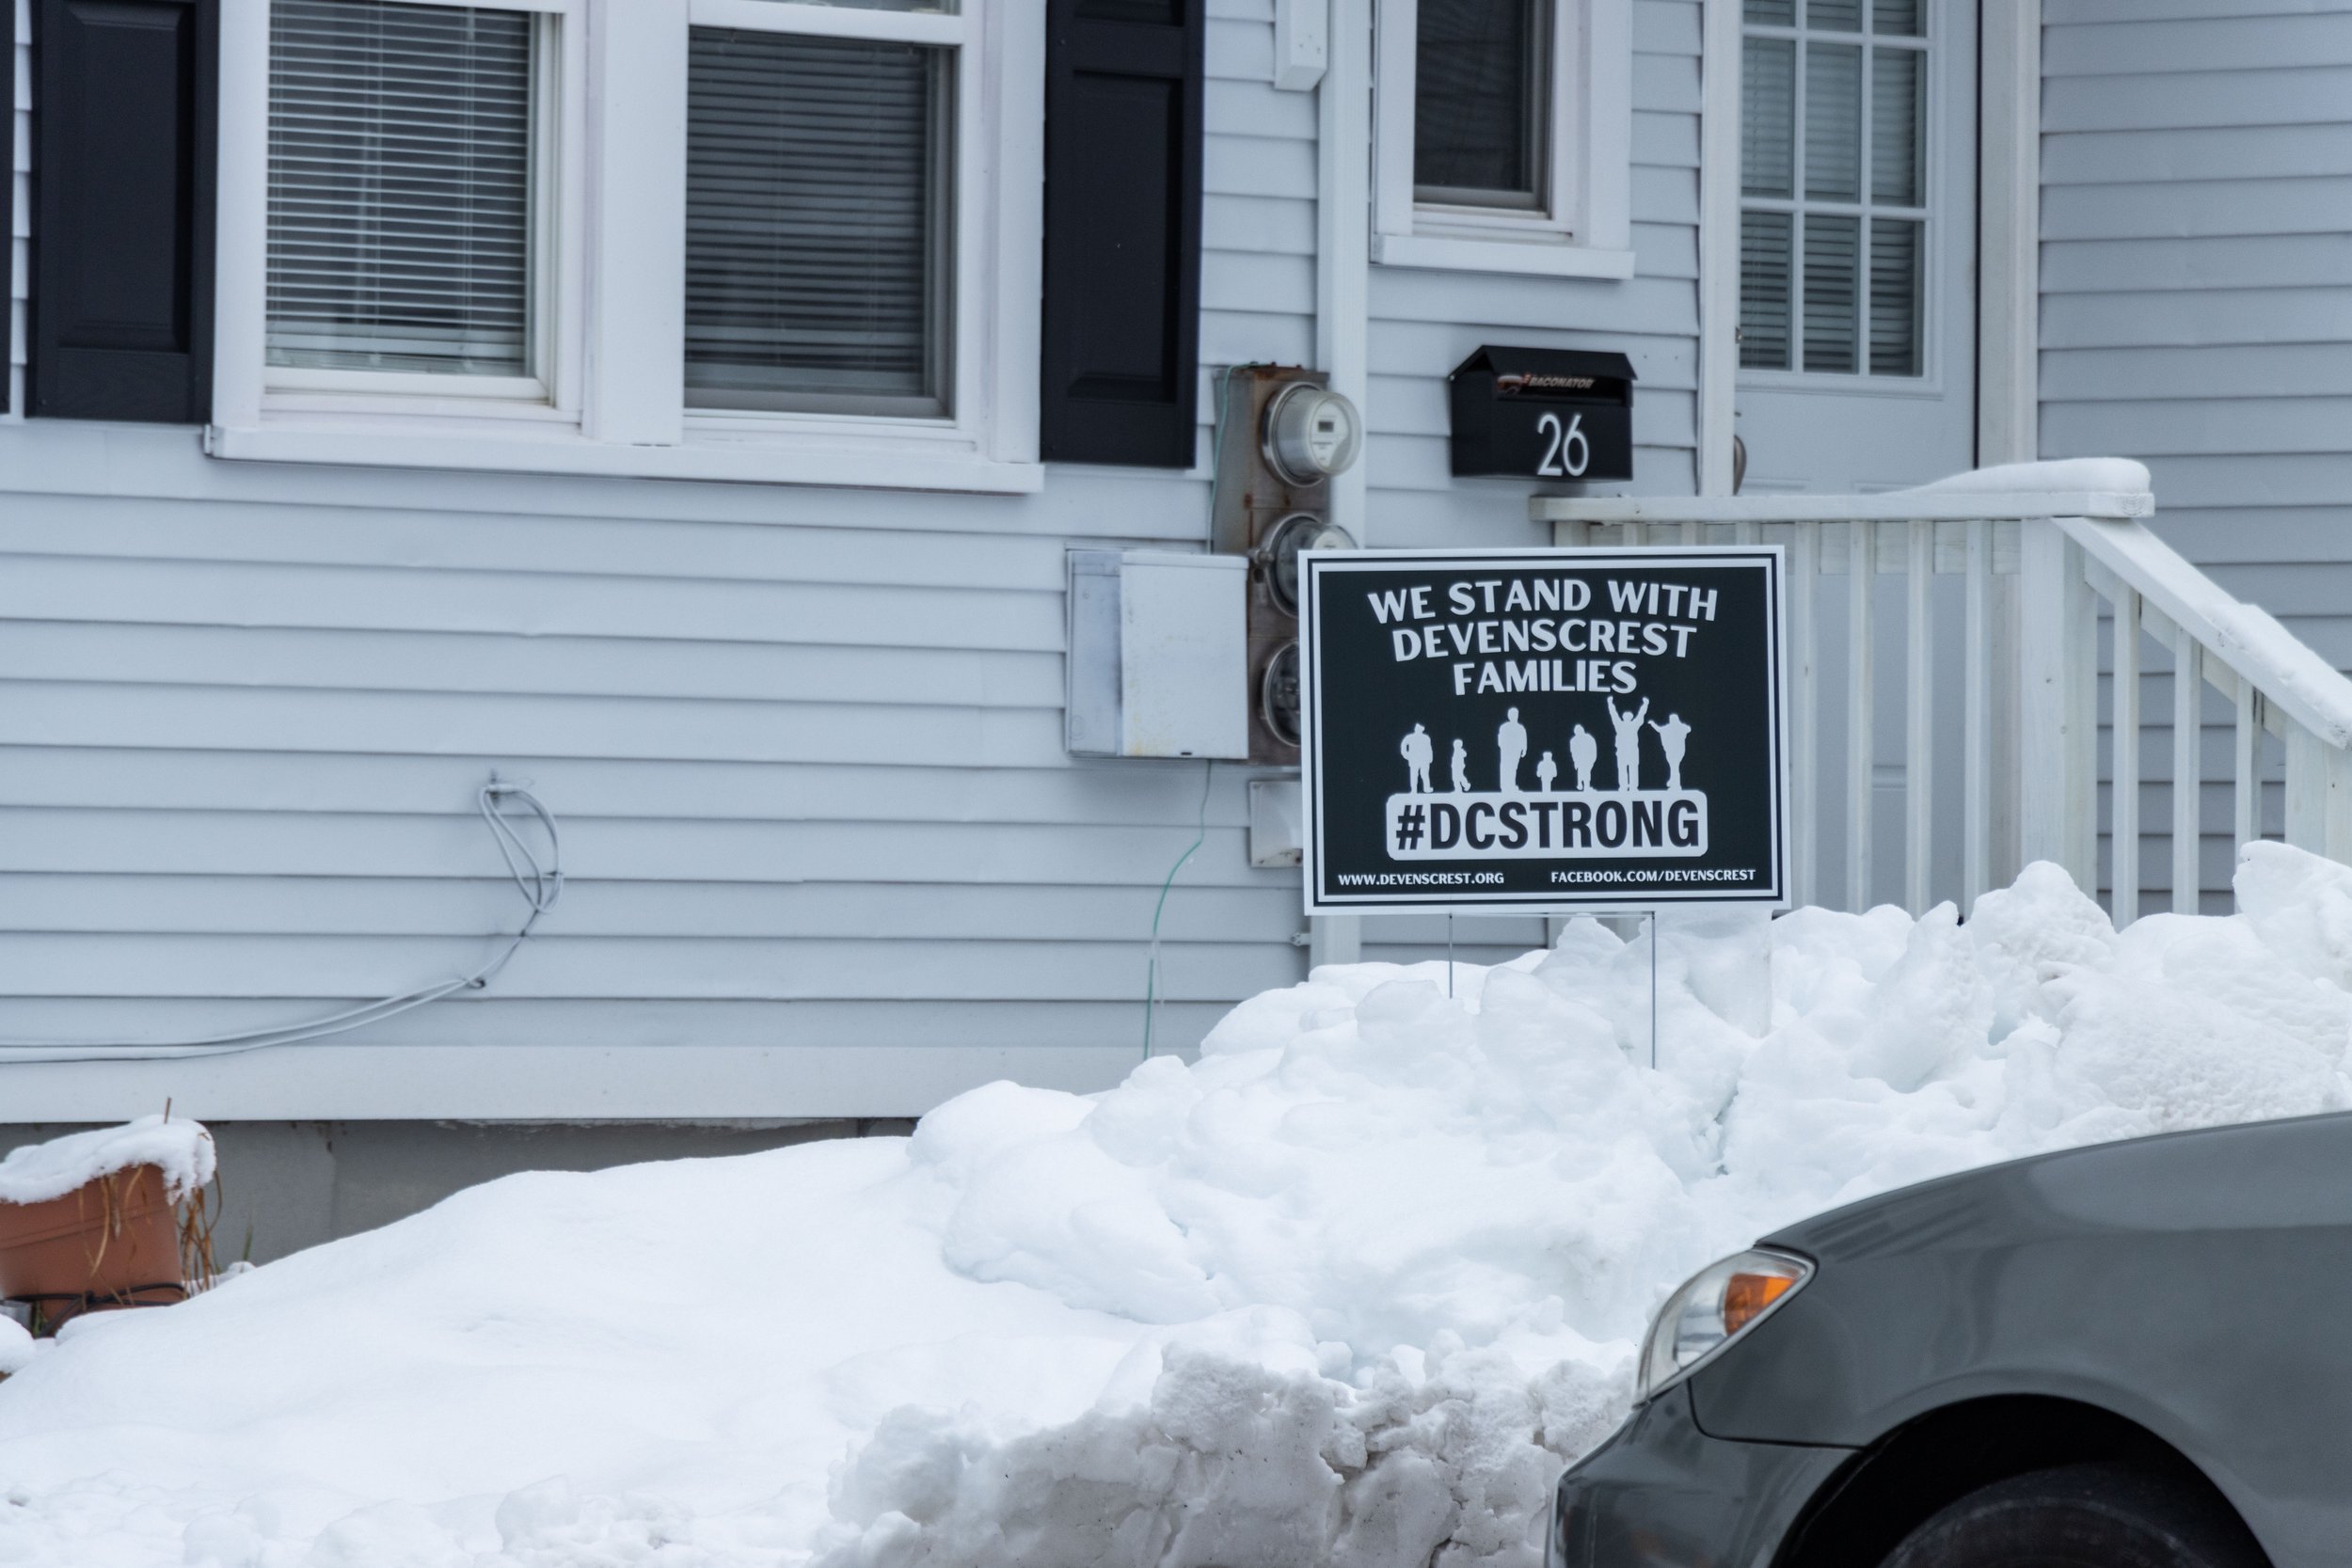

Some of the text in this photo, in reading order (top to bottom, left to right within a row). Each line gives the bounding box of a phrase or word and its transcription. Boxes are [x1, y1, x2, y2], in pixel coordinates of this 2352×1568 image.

[1536, 412, 1589, 477] 26
[1367, 578, 1718, 625] WE STAND WITH
[1391, 618, 1697, 662] DEVENSCREST
[1453, 659, 1637, 696] FAMILIES
[1395, 799, 1699, 850] #DCSTRONG
[1338, 871, 1504, 886] WWW.DEVENSCREST.ORG
[1550, 869, 1756, 883] FACEBOOK.COM/DEVENSCREST
